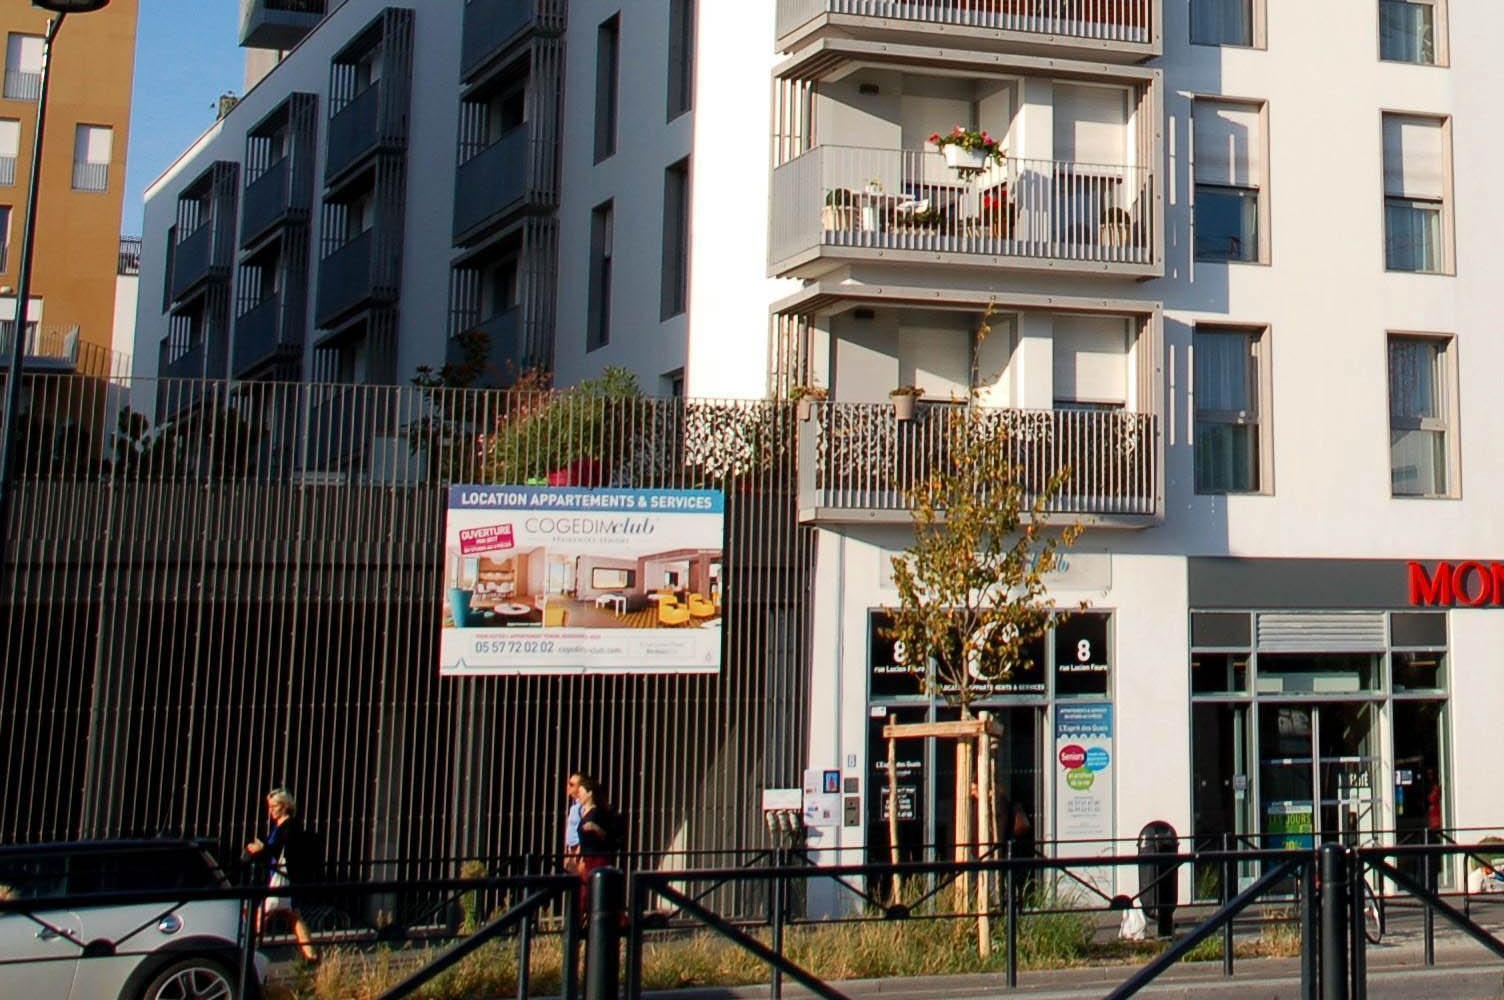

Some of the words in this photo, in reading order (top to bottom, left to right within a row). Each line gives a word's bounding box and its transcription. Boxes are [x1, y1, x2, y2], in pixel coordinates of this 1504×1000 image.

[461, 492, 527, 506] LOCATION
[530, 493, 635, 508] APPARTEMENTS
[638, 496, 648, 508] &
[651, 496, 713, 509] SERVICES
[475, 641, 489, 654] 05
[492, 641, 506, 654] 57
[508, 641, 522, 654] 72
[524, 641, 538, 654] 02
[540, 641, 554, 654] 02
[1077, 639, 1091, 661] 8
